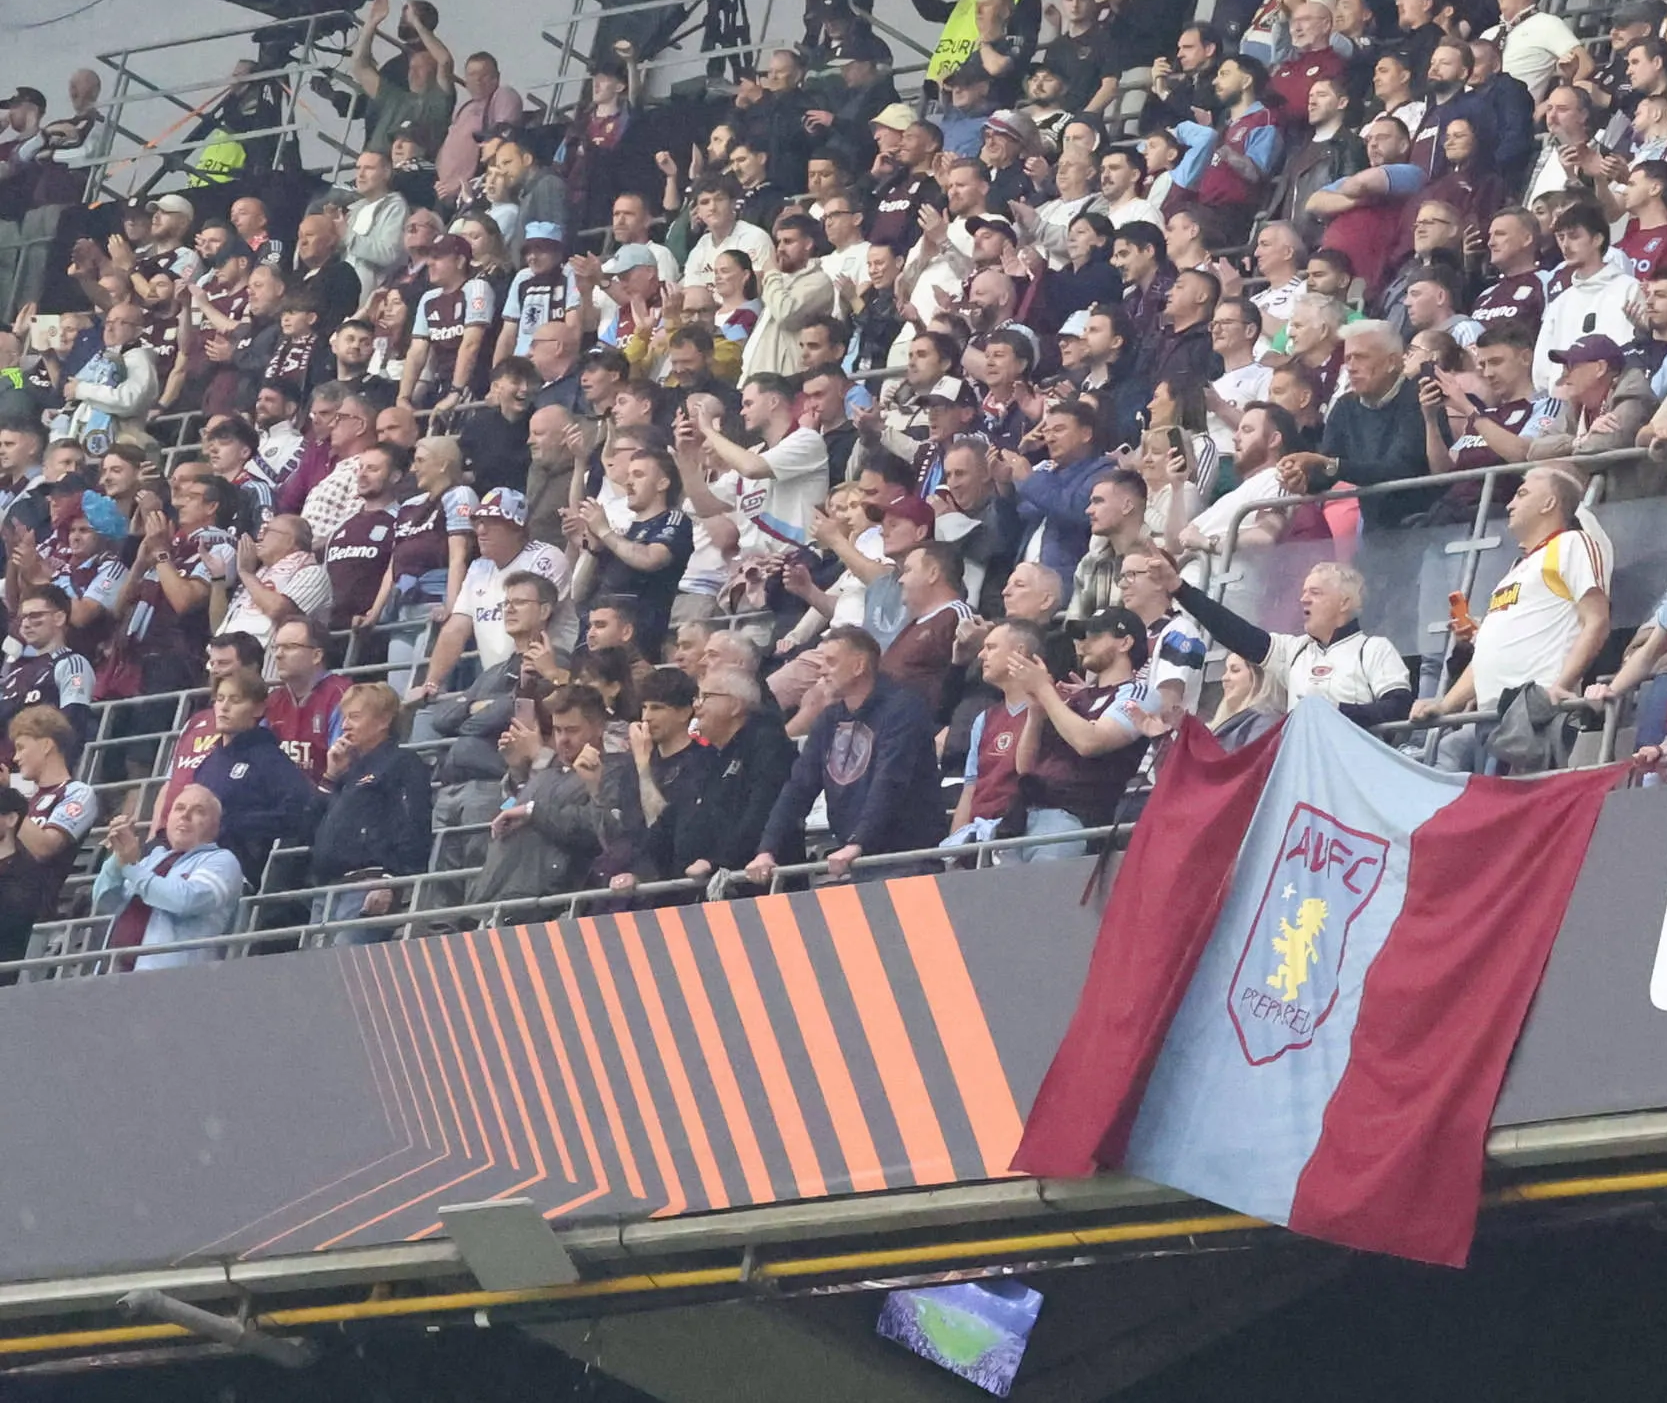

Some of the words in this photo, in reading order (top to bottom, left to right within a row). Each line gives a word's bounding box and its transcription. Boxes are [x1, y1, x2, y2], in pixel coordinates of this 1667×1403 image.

[328, 545, 377, 561] Betano
[476, 606, 503, 624] Bet
[1240, 987, 1311, 1034] PREPARED
